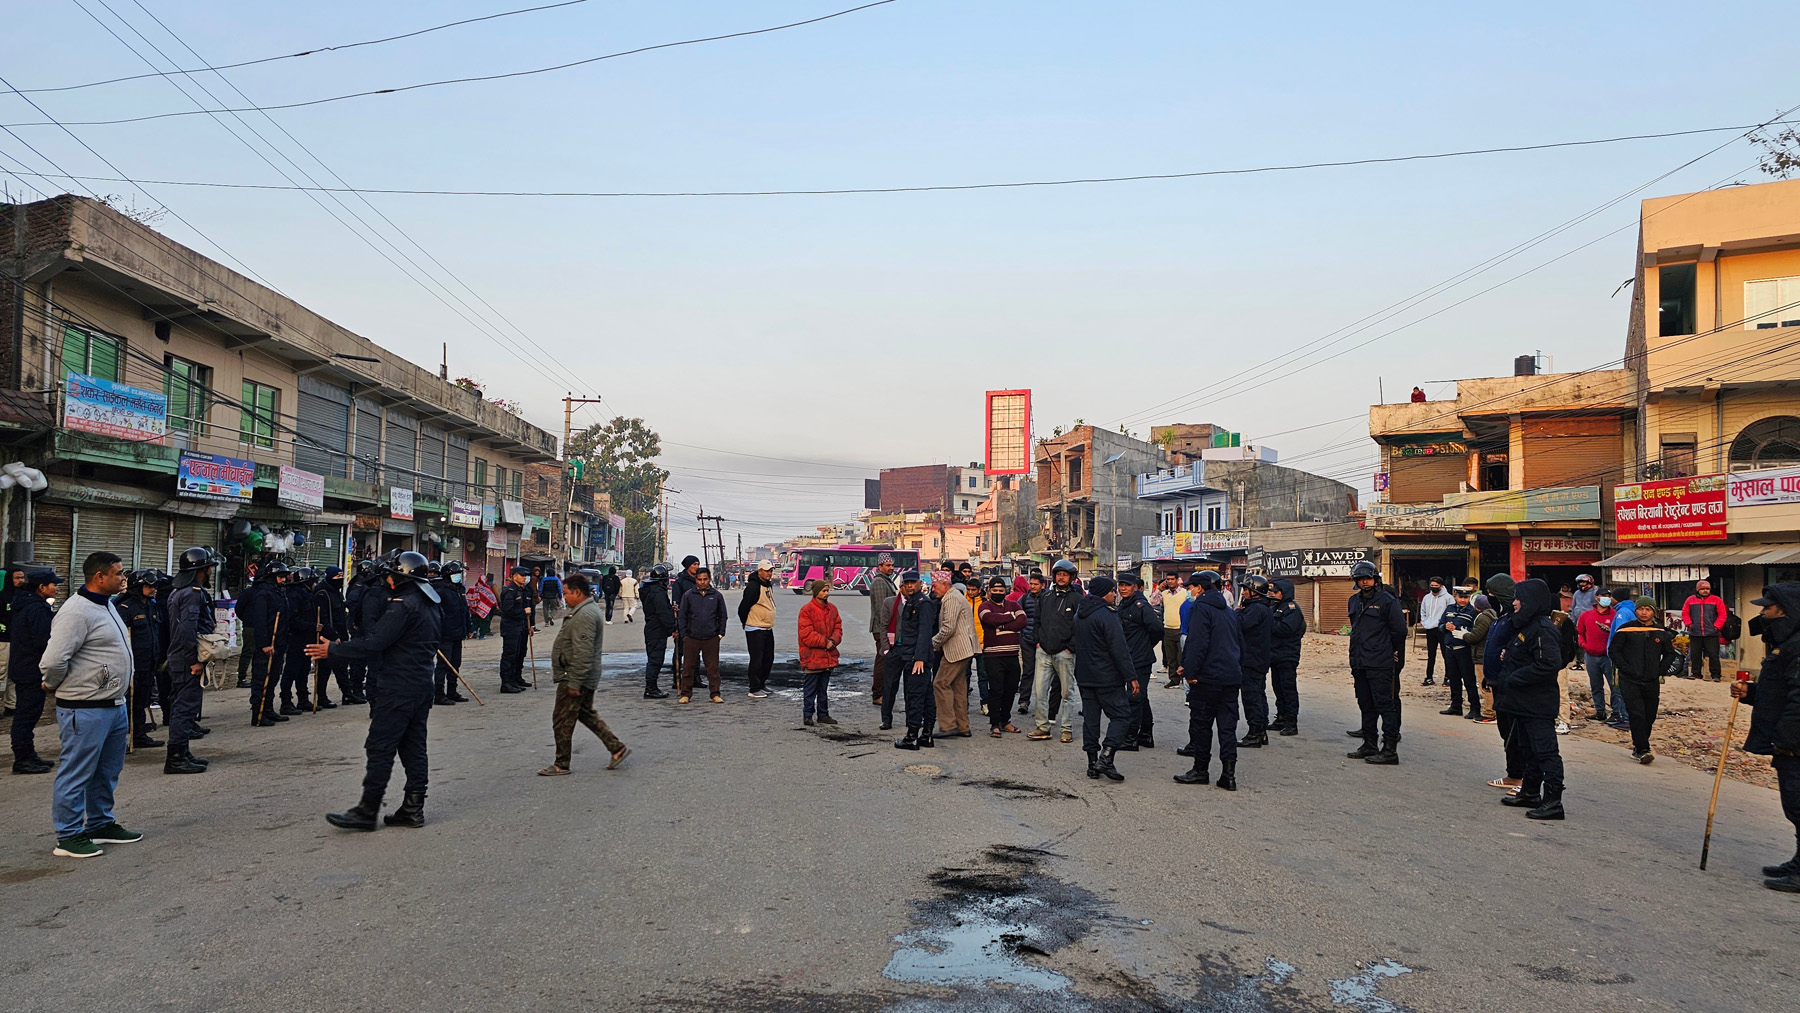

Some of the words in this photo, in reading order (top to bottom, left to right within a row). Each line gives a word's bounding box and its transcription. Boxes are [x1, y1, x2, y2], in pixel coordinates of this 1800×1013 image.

[189, 459, 220, 481] एन्जल
[1731, 478, 1775, 502] भुसाल
[1708, 501, 1724, 515] लज
[1272, 556, 1298, 572] JAWED
[1315, 551, 1366, 563] JAWED
